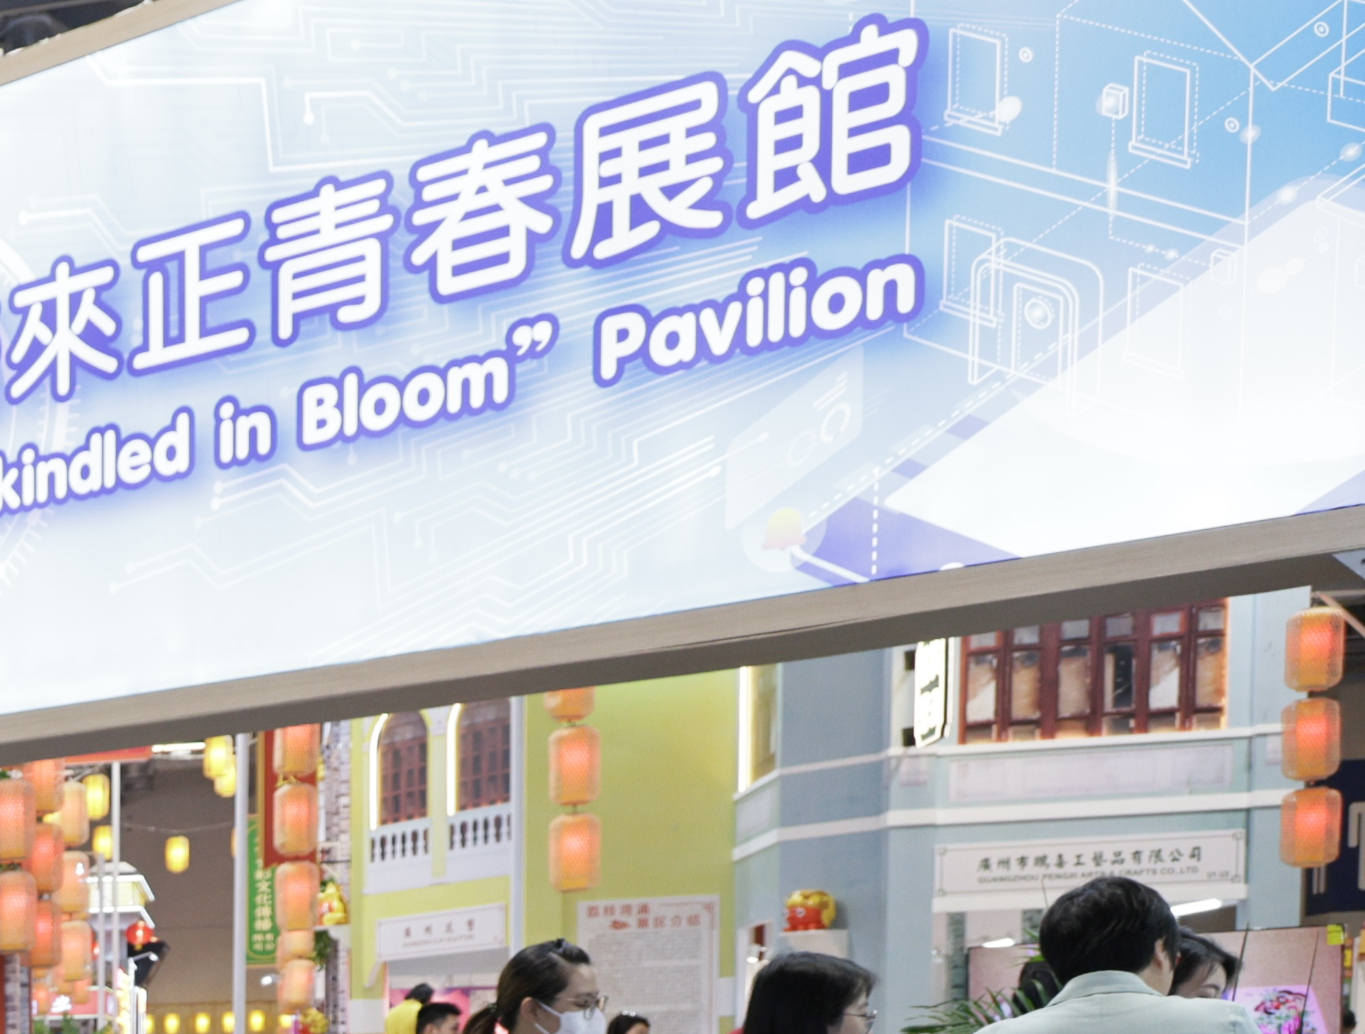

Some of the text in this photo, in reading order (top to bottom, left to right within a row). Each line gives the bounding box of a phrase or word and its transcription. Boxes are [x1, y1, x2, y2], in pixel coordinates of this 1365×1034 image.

[215, 402, 271, 468] in
[299, 322, 553, 448] Bloom”
[597, 258, 921, 384] Pavilion
